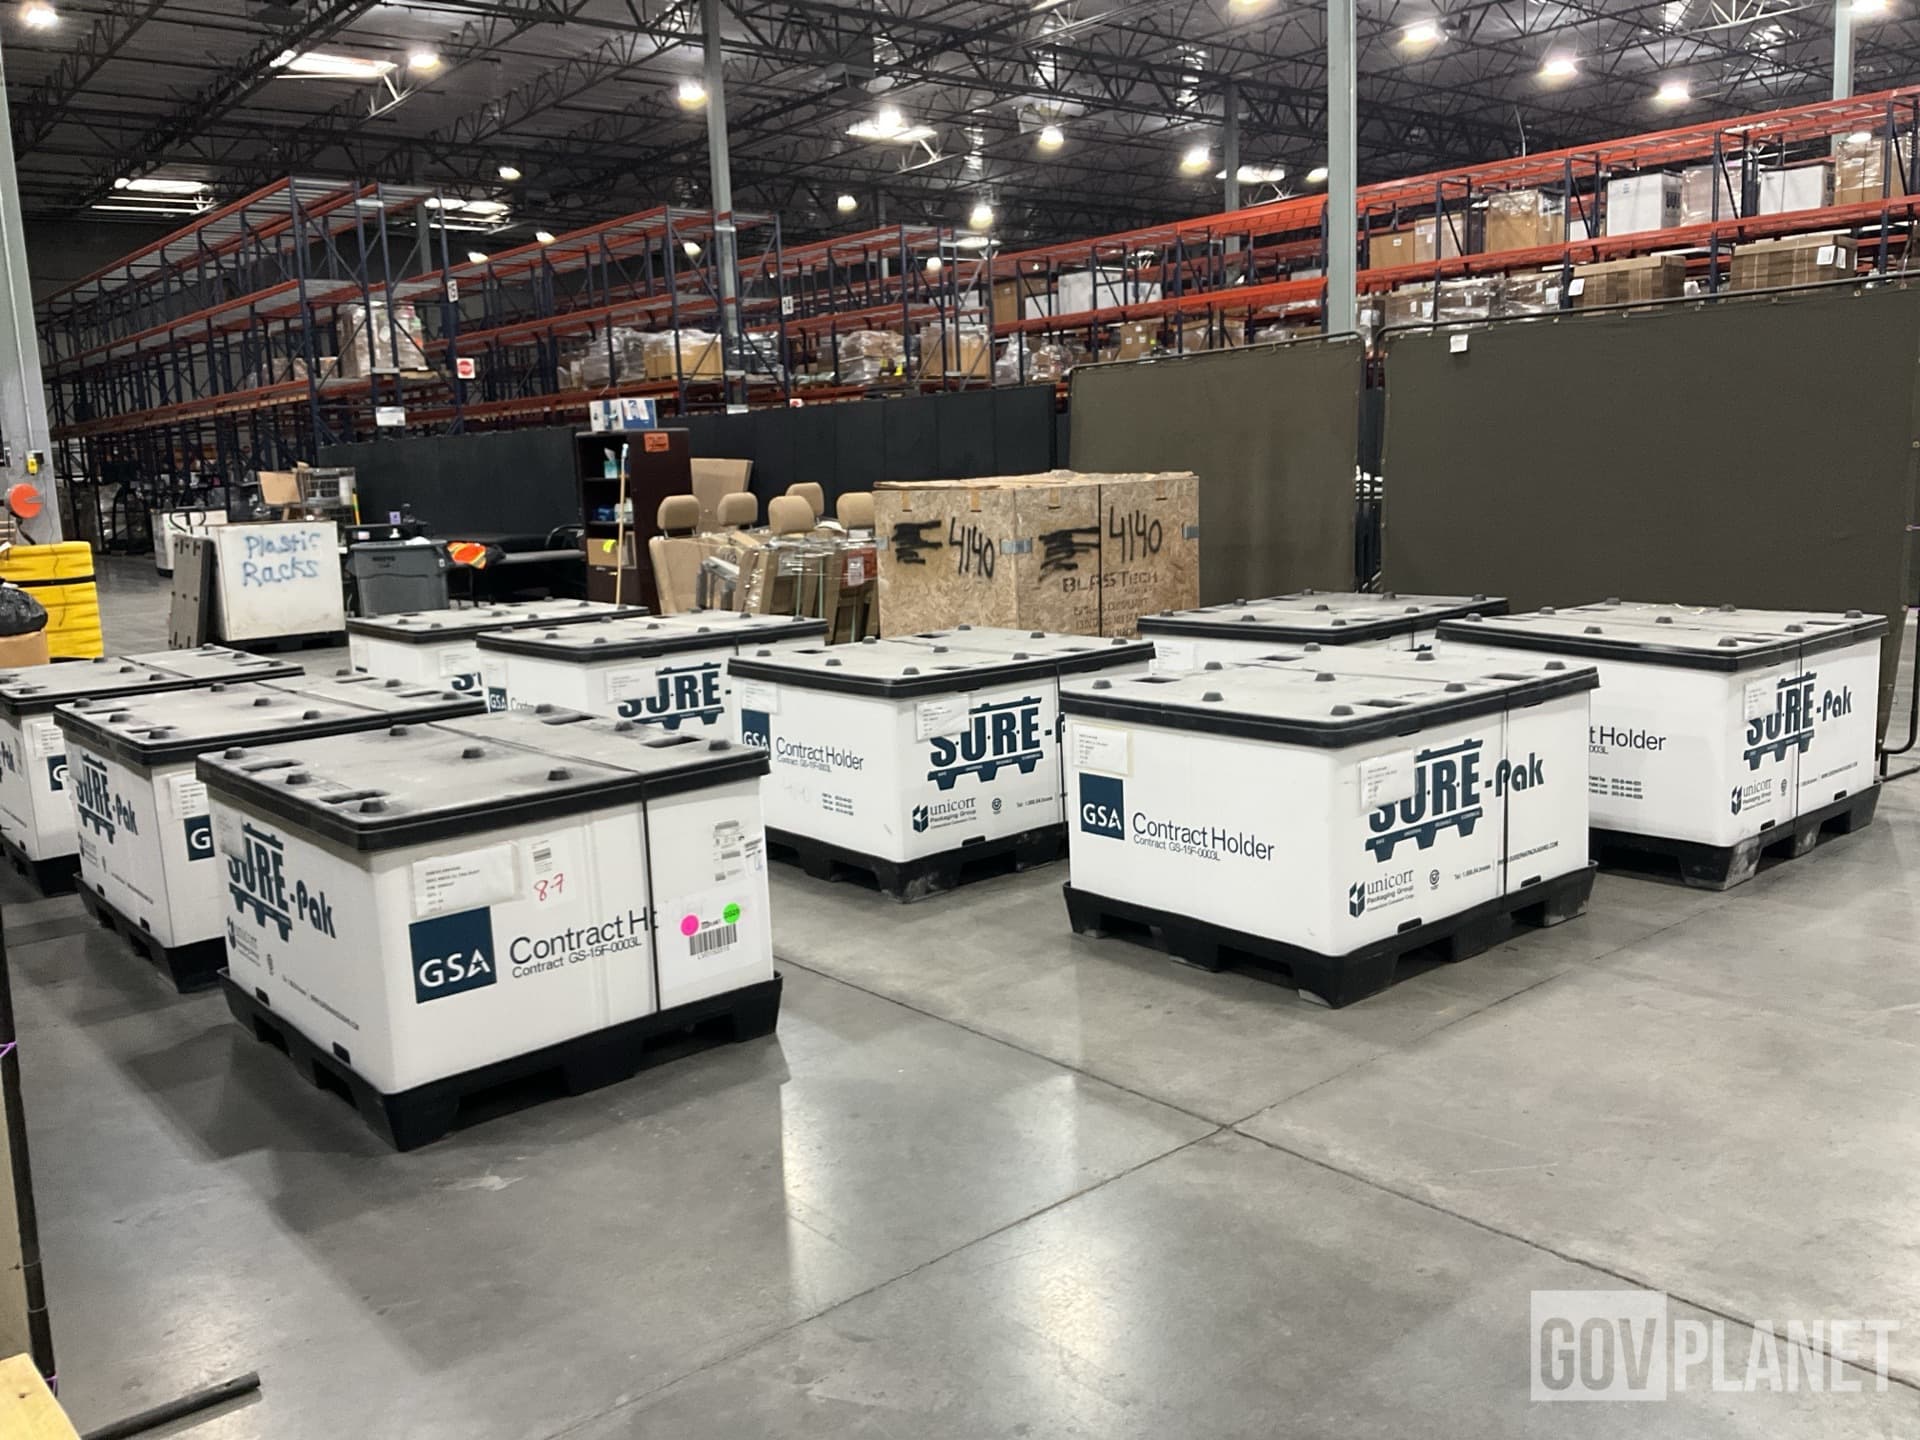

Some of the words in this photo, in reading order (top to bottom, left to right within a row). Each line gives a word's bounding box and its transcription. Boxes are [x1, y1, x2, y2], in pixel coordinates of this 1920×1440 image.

[949, 516, 995, 580] 4140
[1109, 505, 1163, 564] 4140
[242, 556, 319, 587] Racks
[1600, 725, 1667, 750] Holder
[776, 737, 824, 763] Contract
[826, 745, 864, 771] Holder
[1083, 803, 1122, 831] GSA
[1132, 812, 1208, 848] Contract
[1211, 826, 1275, 861] Holder
[1133, 834, 1166, 850] Contract
[1367, 869, 1414, 895] unicorr
[509, 915, 625, 965] Contract
[418, 949, 491, 988] GSA
[511, 956, 565, 979] Contract
